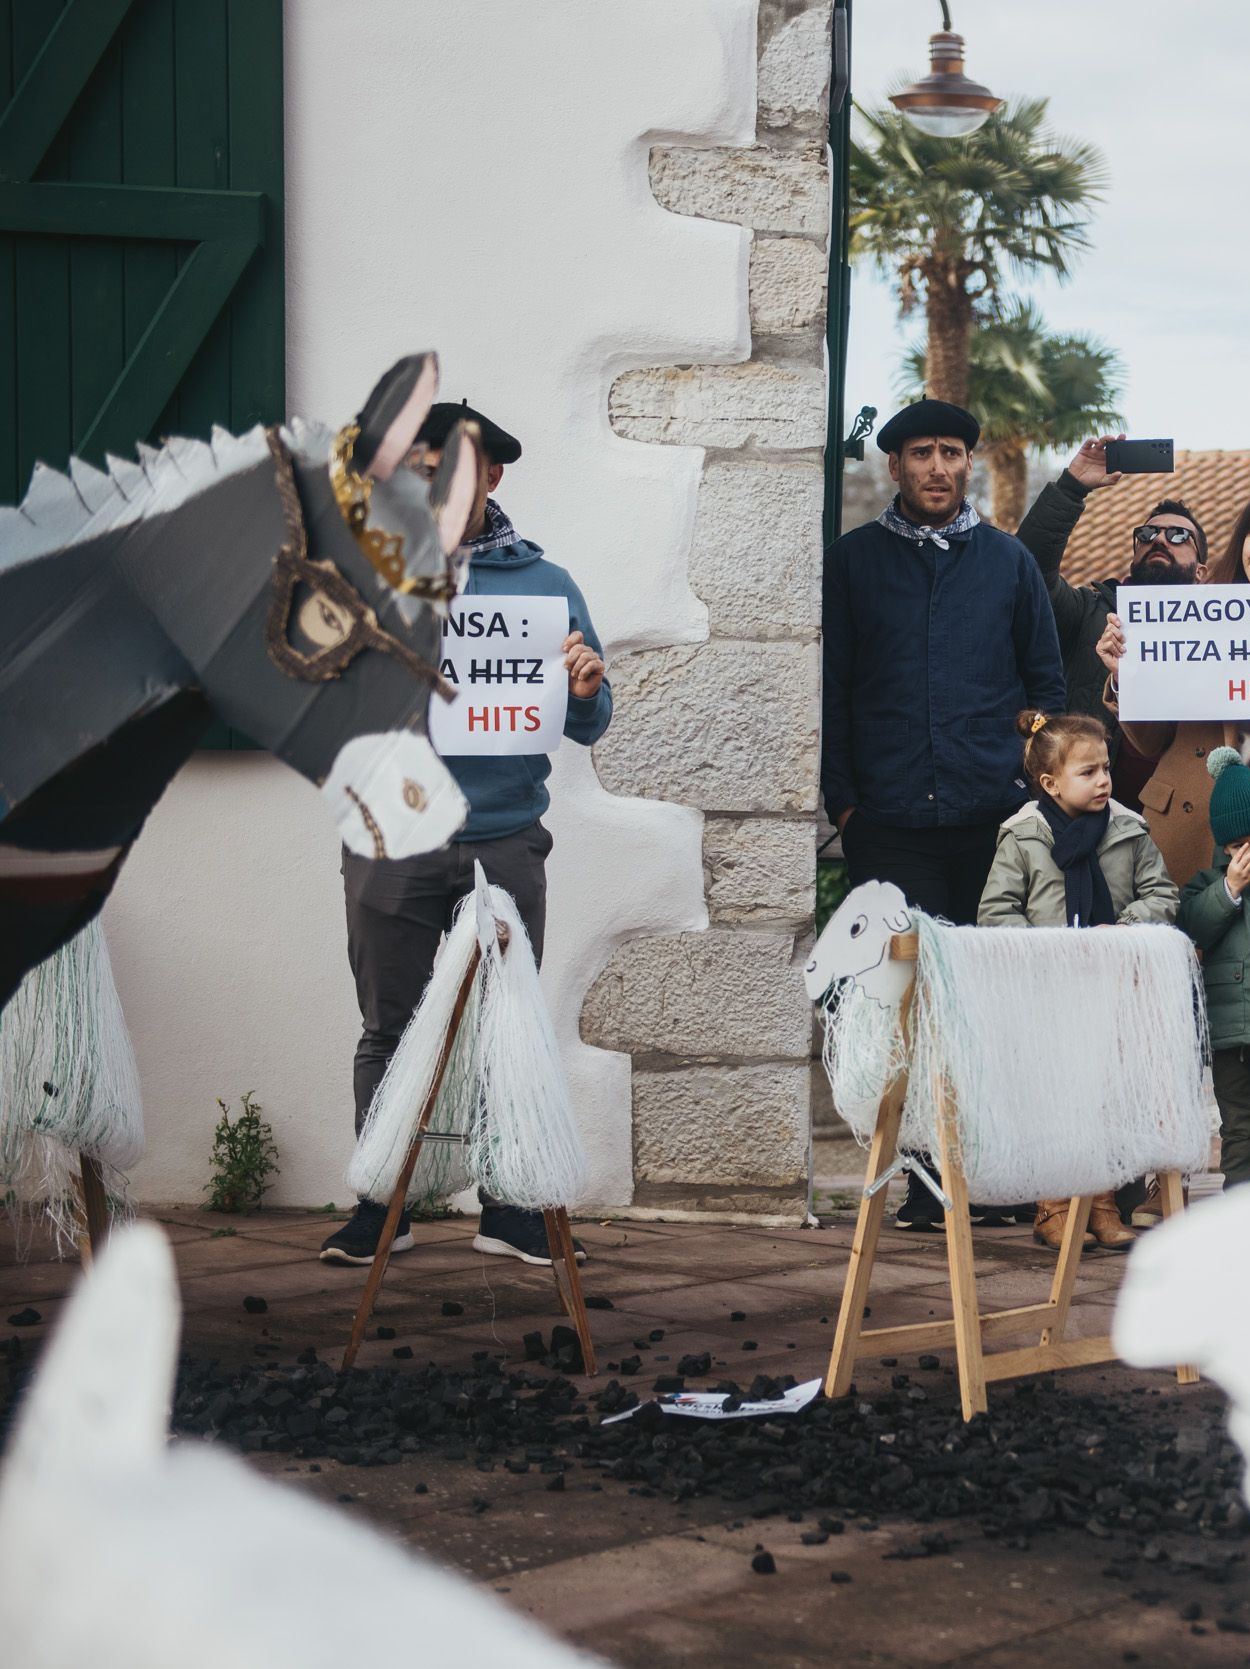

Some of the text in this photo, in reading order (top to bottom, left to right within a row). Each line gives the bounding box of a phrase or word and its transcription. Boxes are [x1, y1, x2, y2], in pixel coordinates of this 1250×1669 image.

[1140, 640, 1221, 662] HITZA
[468, 658, 544, 684] HITZ
[468, 706, 541, 732] HITS
